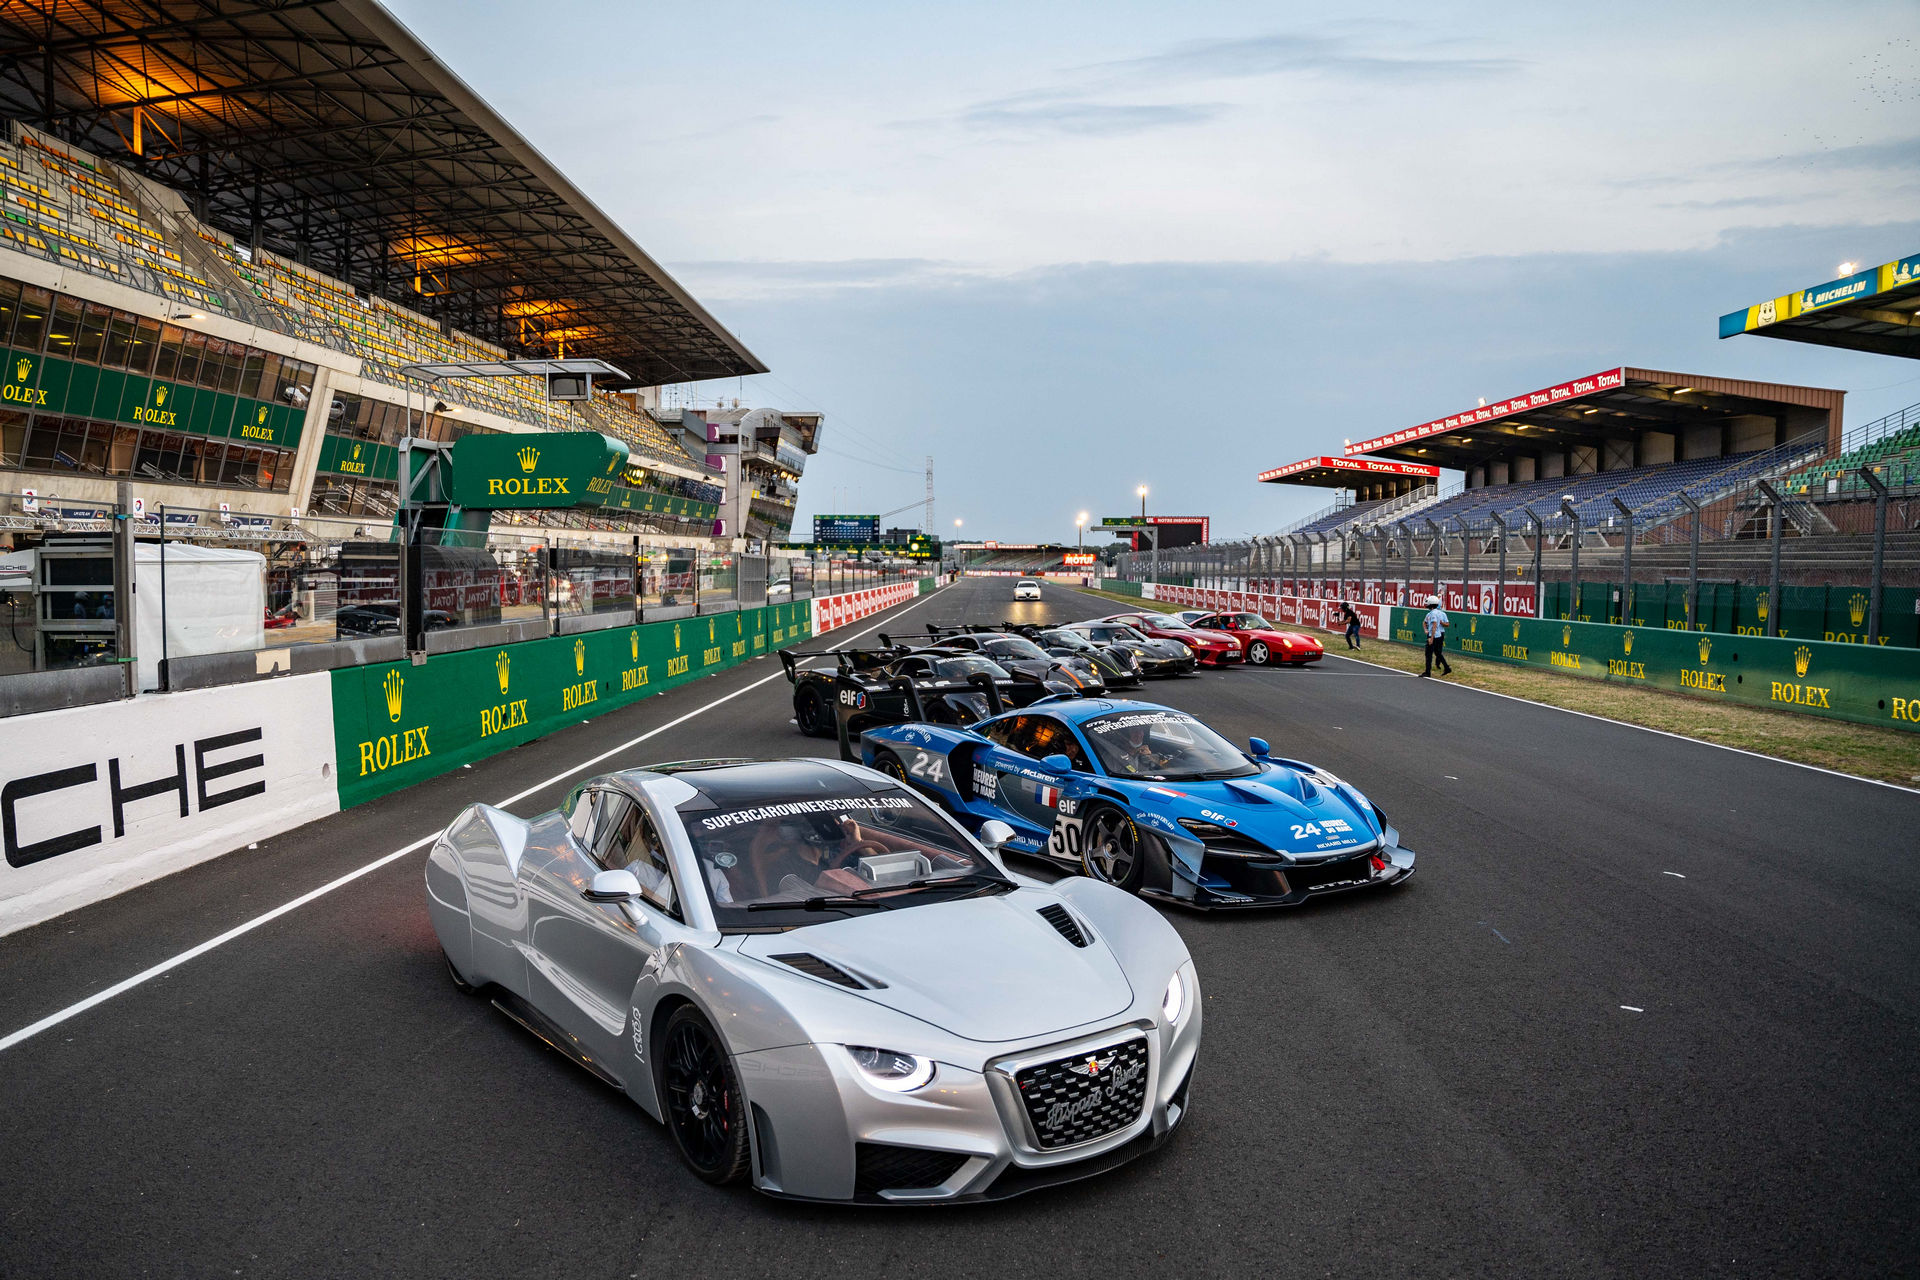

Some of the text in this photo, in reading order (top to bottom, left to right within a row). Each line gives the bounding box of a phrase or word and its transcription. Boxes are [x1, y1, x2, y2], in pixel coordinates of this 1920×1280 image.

[1816, 280, 1866, 304] MICHELIN
[1445, 418, 1459, 428] TOTAL
[1460, 414, 1474, 424] TOTAL
[1476, 410, 1491, 419] TOTAL
[1492, 405, 1508, 415] TOTAL
[1510, 400, 1528, 410] TOTAL
[1530, 393, 1549, 405] TOTAL
[1550, 387, 1571, 399] TOTAL
[1573, 380, 1595, 394] TOTAL
[1597, 374, 1620, 387] TOTAL
[134, 406, 176, 426] ROLEX
[242, 424, 274, 441] ROLEX
[340, 460, 365, 474] ROLEX
[1332, 458, 1430, 474] TOTAL TOTAL TOTAL
[488, 478, 570, 495] ROLEX
[586, 477, 614, 494] ROLEX
[1232, 597, 1241, 608] TOTAL
[1247, 598, 1257, 610] TOTAL
[1264, 600, 1274, 613] TOTAL
[1282, 602, 1295, 616] TOTAL
[1304, 605, 1318, 620] TOTAL
[1397, 629, 1413, 641] ROLEX
[1462, 639, 1483, 653] ROLEX
[1503, 645, 1528, 660] ROLEX
[1551, 651, 1581, 669] ROLEX
[1609, 659, 1645, 679] ROLEX
[1680, 669, 1726, 693] ROLEX
[1771, 682, 1830, 708] ROLEX
[840, 690, 856, 705] elf
[358, 726, 431, 776] ROLEX
[481, 699, 528, 738] ROLEX
[563, 679, 598, 712] ROLEX
[622, 665, 648, 691] ROLEX
[668, 655, 688, 677] ROLEX
[704, 646, 720, 666] ROLEX
[911, 752, 943, 782] 24
[995, 761, 1014, 771] powered
[1020, 768, 1056, 783] McLaren
[974, 768, 996, 788] HEURES
[980, 786, 996, 799] MANS
[702, 798, 912, 830] SUPERCAROWNERSCIRCLE.COM
[1059, 800, 1076, 814] elf
[1201, 809, 1225, 821] elf
[1053, 820, 1080, 856] 50
[1290, 823, 1321, 840] 24
[1316, 840, 1341, 849] RICHARD
[1046, 1090, 1102, 1129] Hispano
